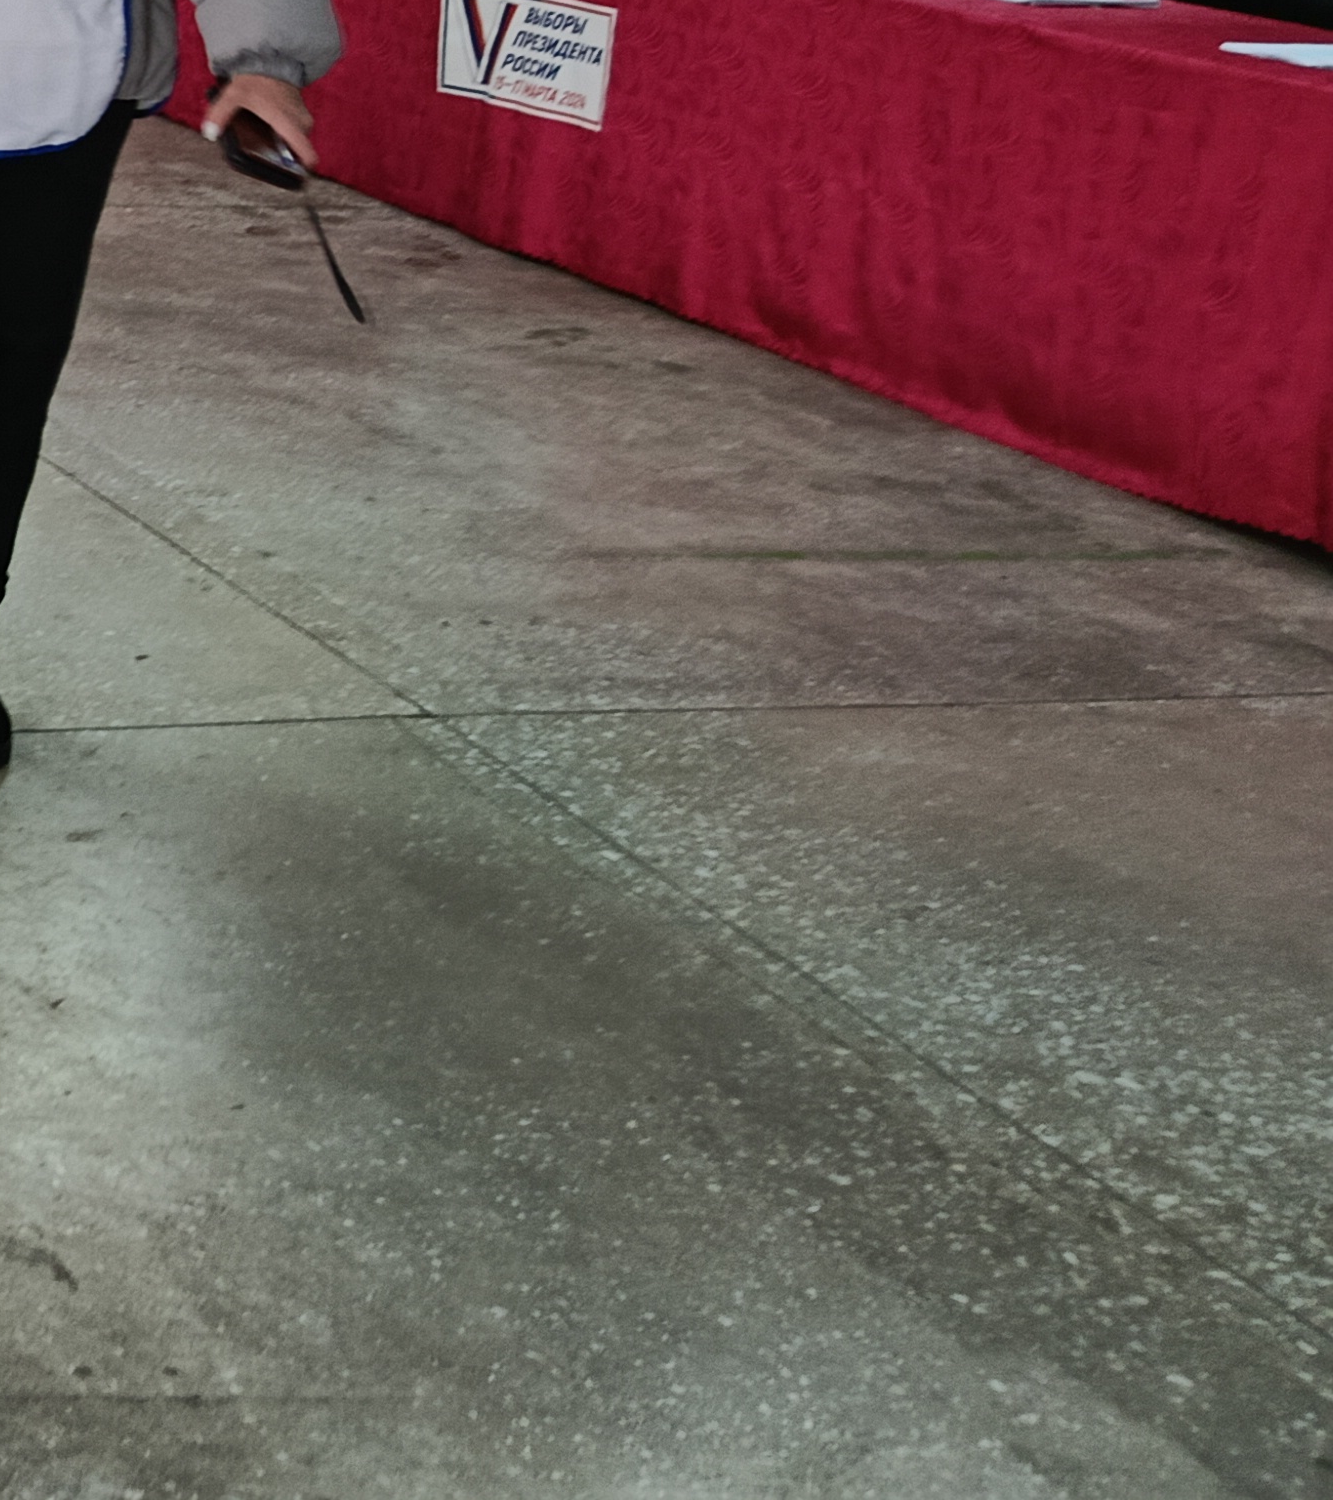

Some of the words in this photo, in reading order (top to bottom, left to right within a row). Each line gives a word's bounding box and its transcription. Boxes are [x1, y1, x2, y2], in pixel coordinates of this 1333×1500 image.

[523, 7, 588, 35] ВЫБОРЫ
[512, 30, 603, 66] ПРЕЗИДЕНТА
[501, 53, 562, 81] РОССИИ
